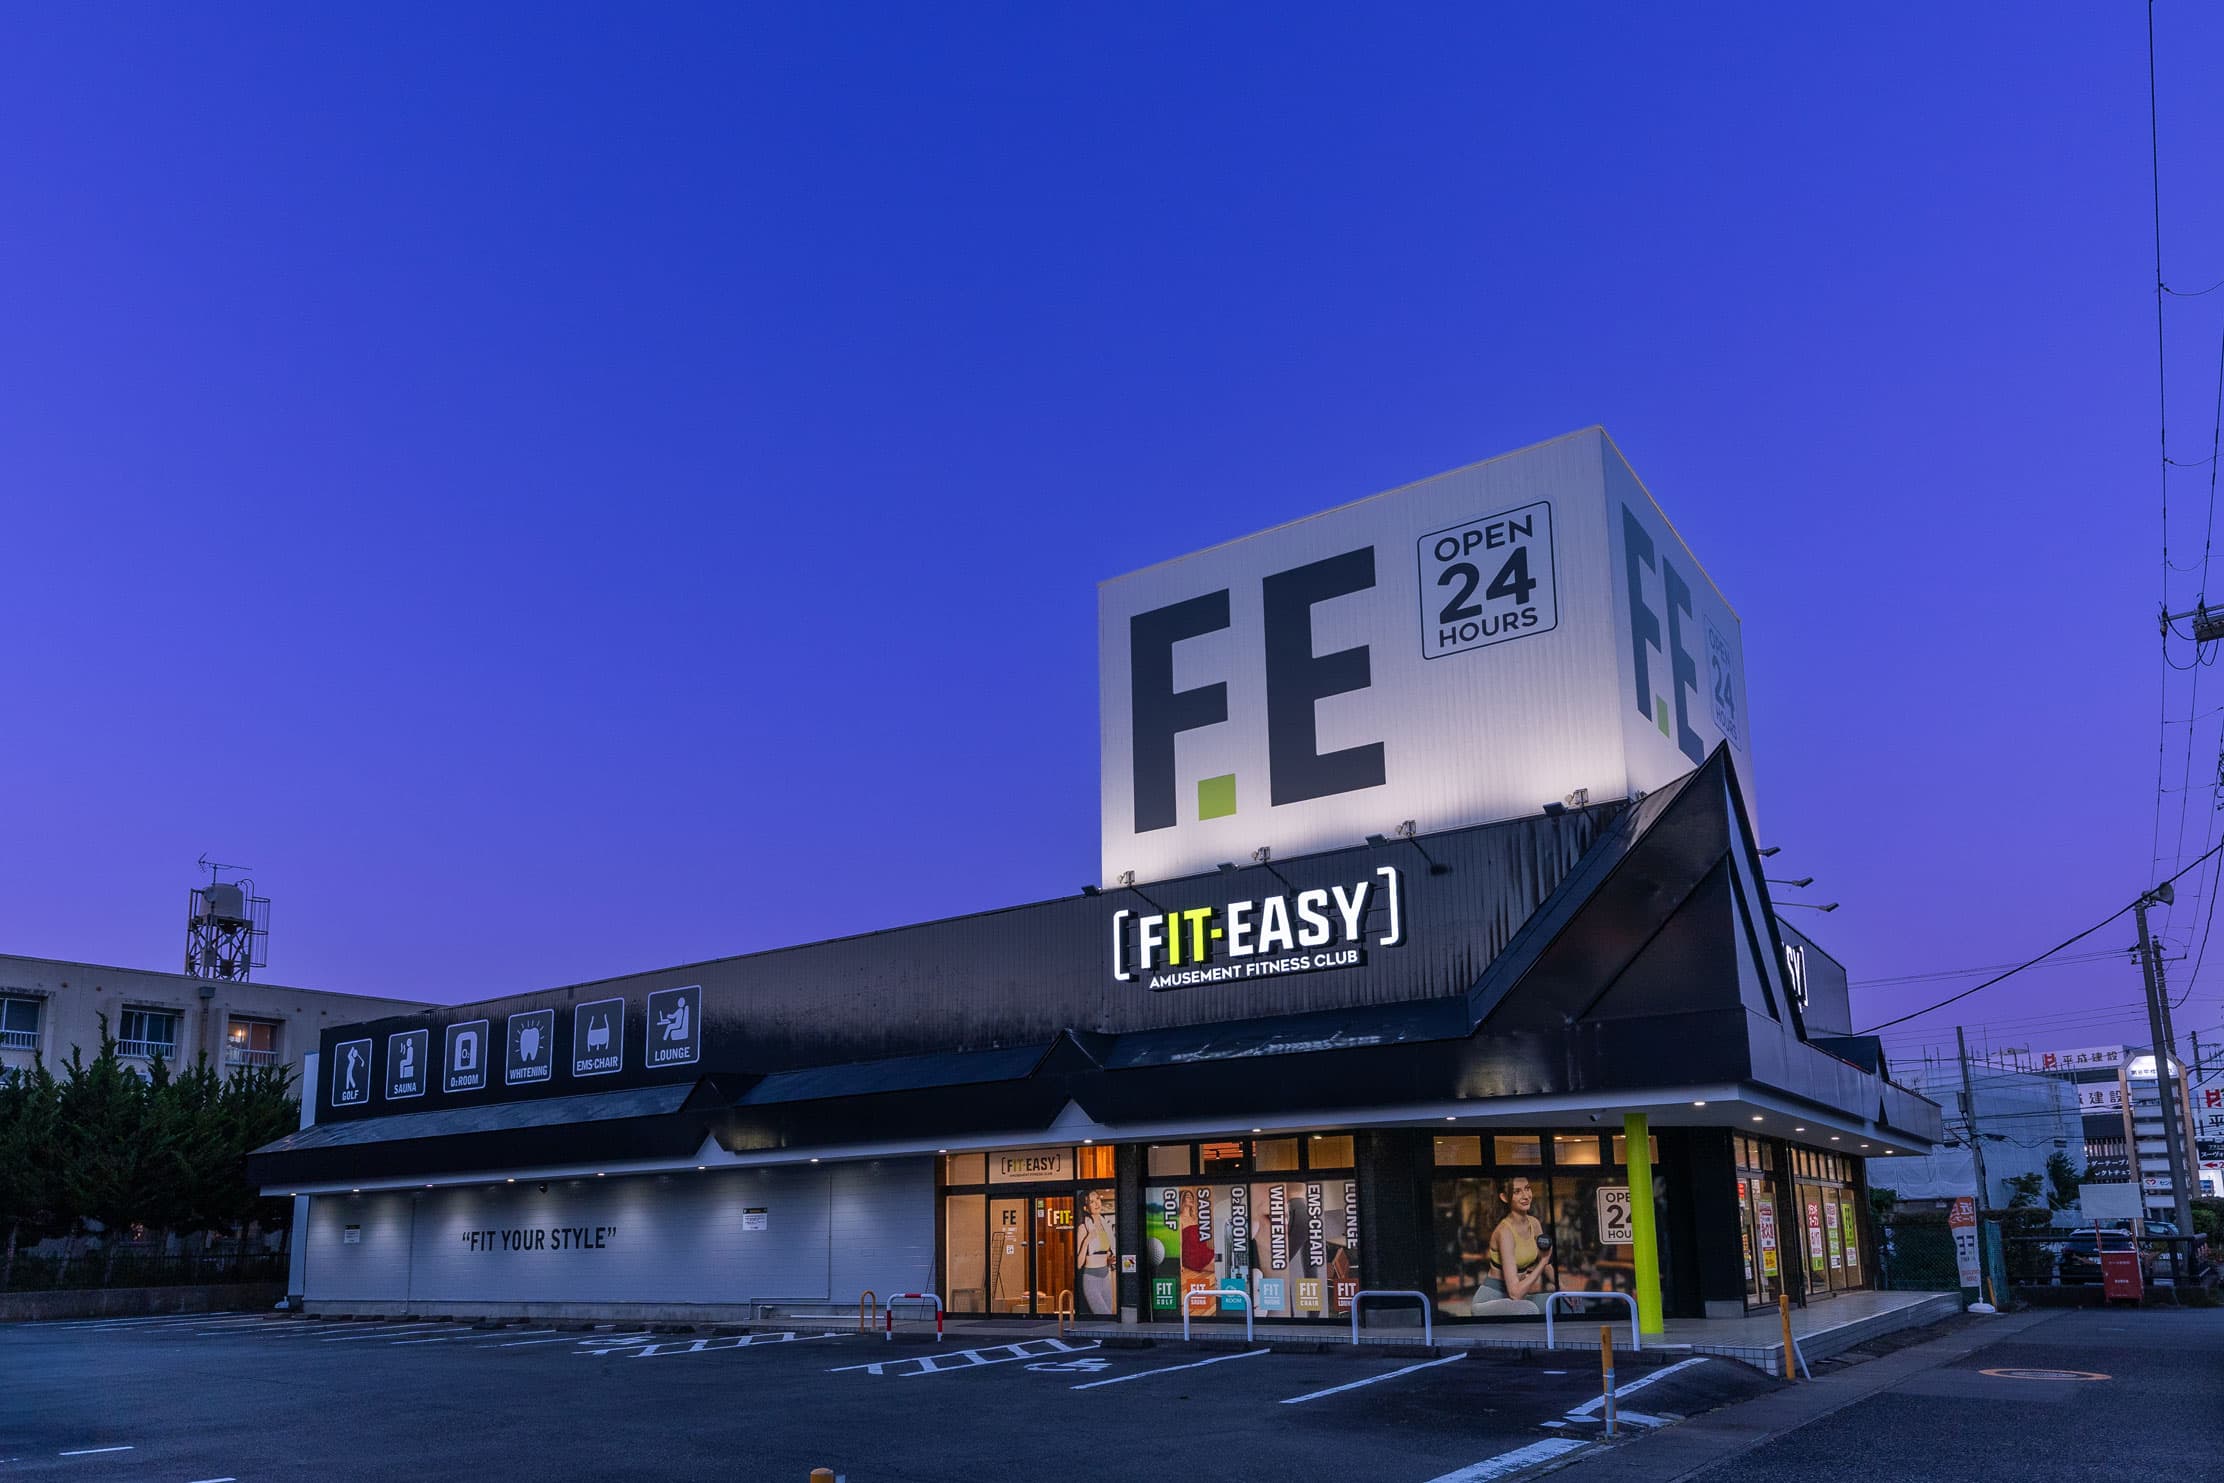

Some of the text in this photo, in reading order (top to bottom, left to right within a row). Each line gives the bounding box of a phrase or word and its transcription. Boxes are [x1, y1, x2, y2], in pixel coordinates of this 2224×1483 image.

[1434, 514, 1534, 562] OPEN
[1437, 546, 1537, 624] 24
[1439, 607, 1538, 647] HOURS
[1708, 628, 1731, 665] OPEN
[1711, 655, 1736, 719] 24
[1716, 706, 1738, 741] HOURS
[1149, 949, 1358, 989] AMUSEMENT FITNESS CLUB
[654, 1046, 690, 1062] LOUNGE
[2062, 1051, 2118, 1065] 平成建設
[509, 1065, 548, 1080] WHITENING
[342, 1089, 360, 1101] GOLF
[393, 1082, 417, 1095] SAUNA
[1163, 1189, 1177, 1231] GOLF
[1197, 1188, 1211, 1242] SAUNA
[501, 1229, 545, 1250] YOUR
[1270, 1186, 1286, 1269] WHITENING
[1156, 1282, 1173, 1296] FIT
[1263, 1283, 1279, 1296] FIT
[1299, 1282, 1318, 1296] FIT
[1337, 1282, 1356, 1296] FIT
